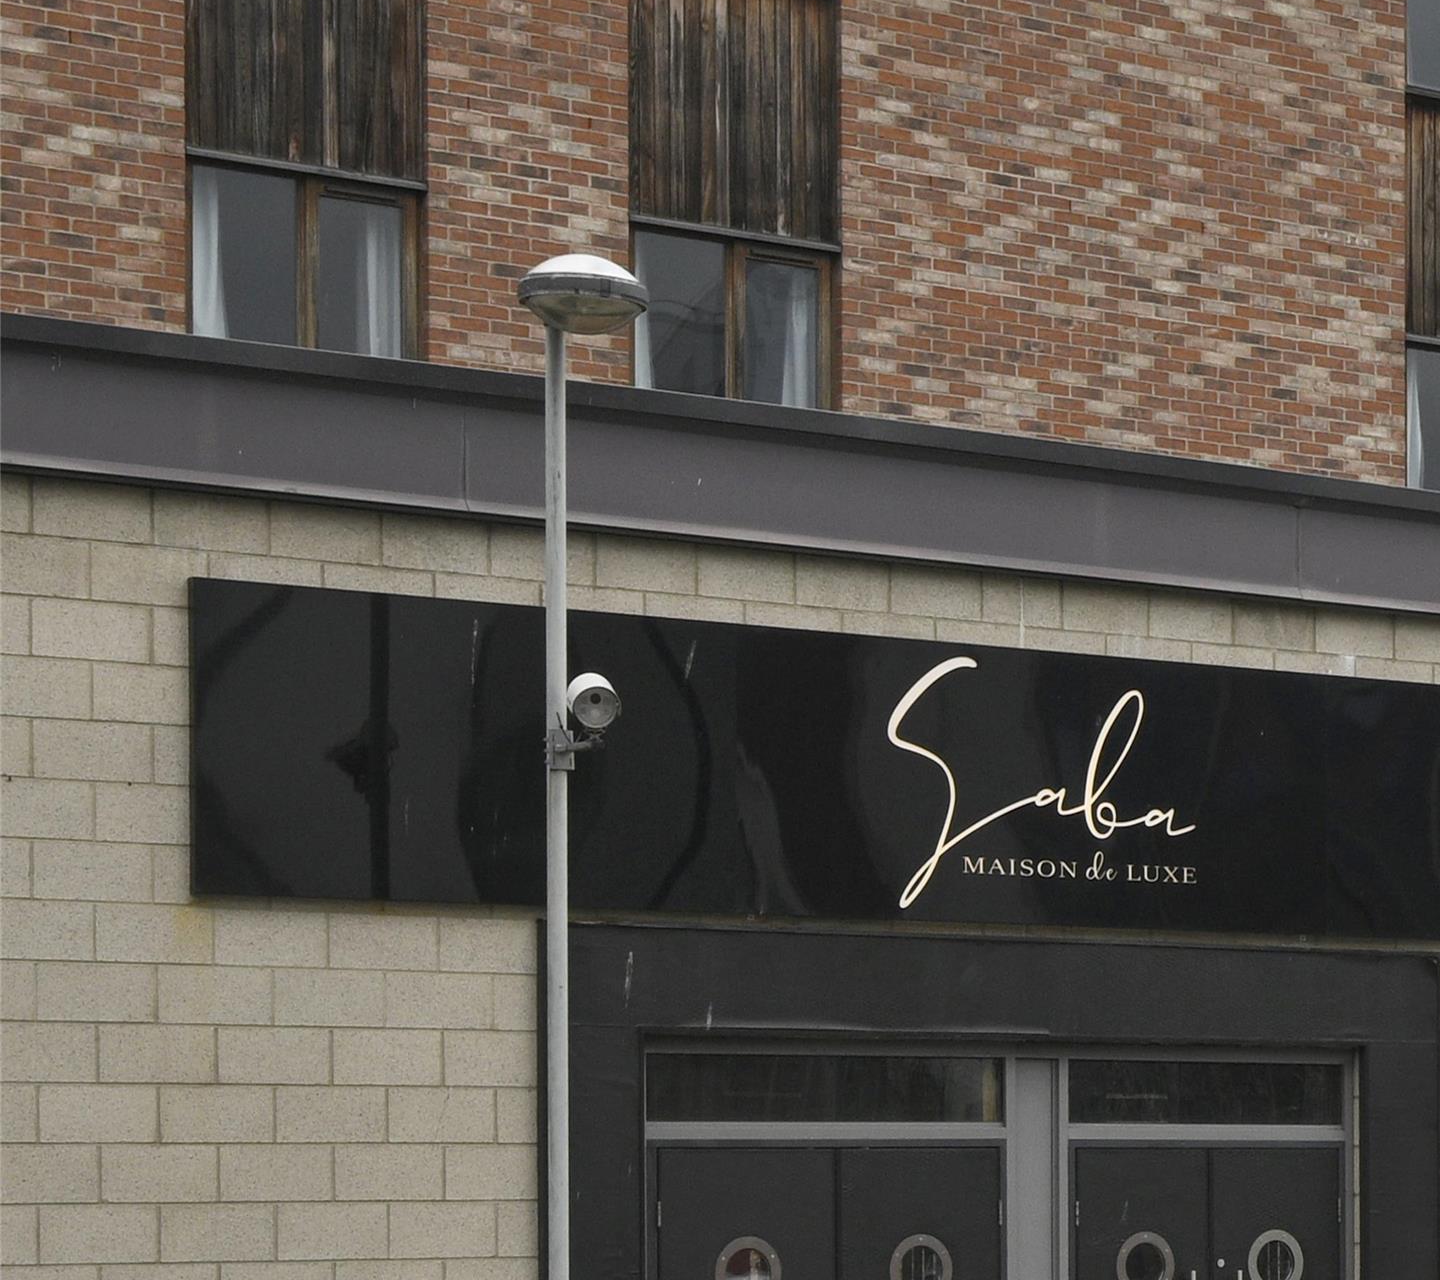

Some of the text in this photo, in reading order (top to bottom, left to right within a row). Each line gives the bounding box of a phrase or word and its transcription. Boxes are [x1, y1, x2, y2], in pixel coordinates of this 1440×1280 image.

[887, 656, 1196, 909] Saba
[962, 850, 1197, 884] MAISON de LUXE
